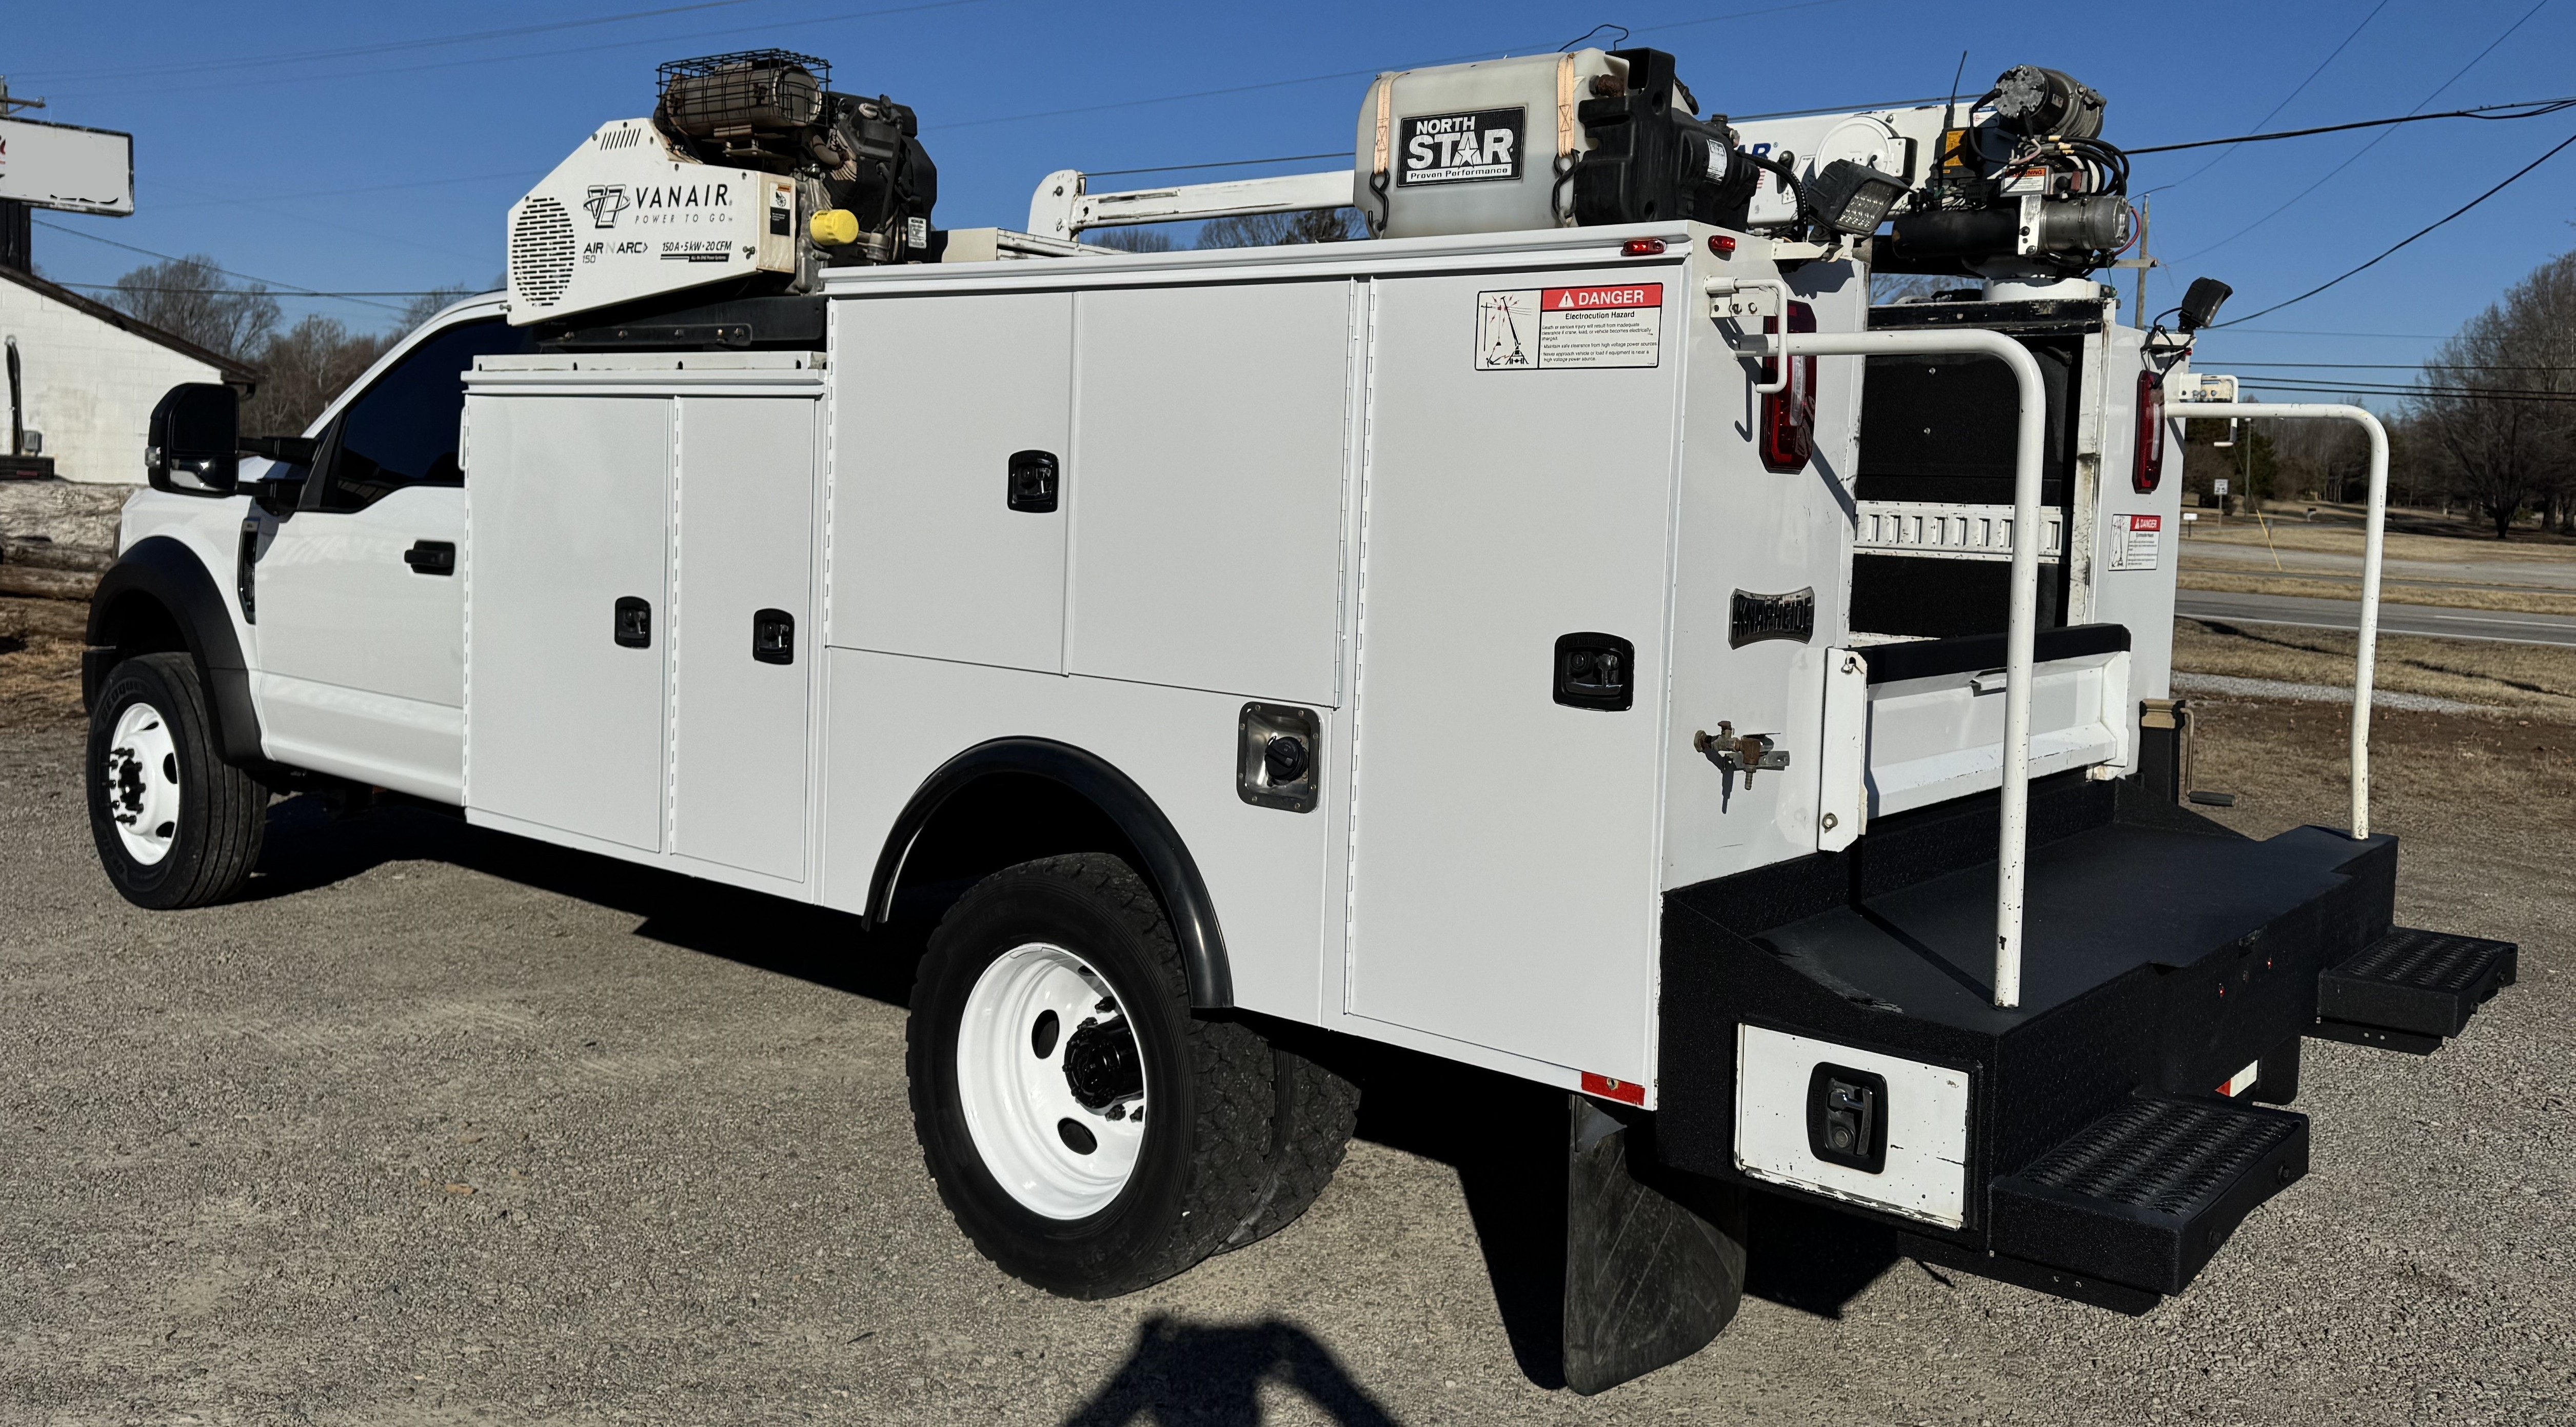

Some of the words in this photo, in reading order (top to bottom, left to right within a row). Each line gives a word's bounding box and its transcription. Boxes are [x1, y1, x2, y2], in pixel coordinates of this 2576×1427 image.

[1416, 116, 1475, 135] NORTH
[1408, 128, 1514, 169] STAR
[1446, 168, 1508, 177] Performance
[636, 184, 728, 209] VANAIR
[635, 214, 674, 224] POWER
[685, 213, 698, 223] TO
[710, 213, 725, 222] GO
[583, 255, 596, 263] 150
[1579, 290, 1644, 306] DANGER
[2140, 519, 2157, 528] DANGER
[1735, 595, 1812, 638] KNAPHEIDE
